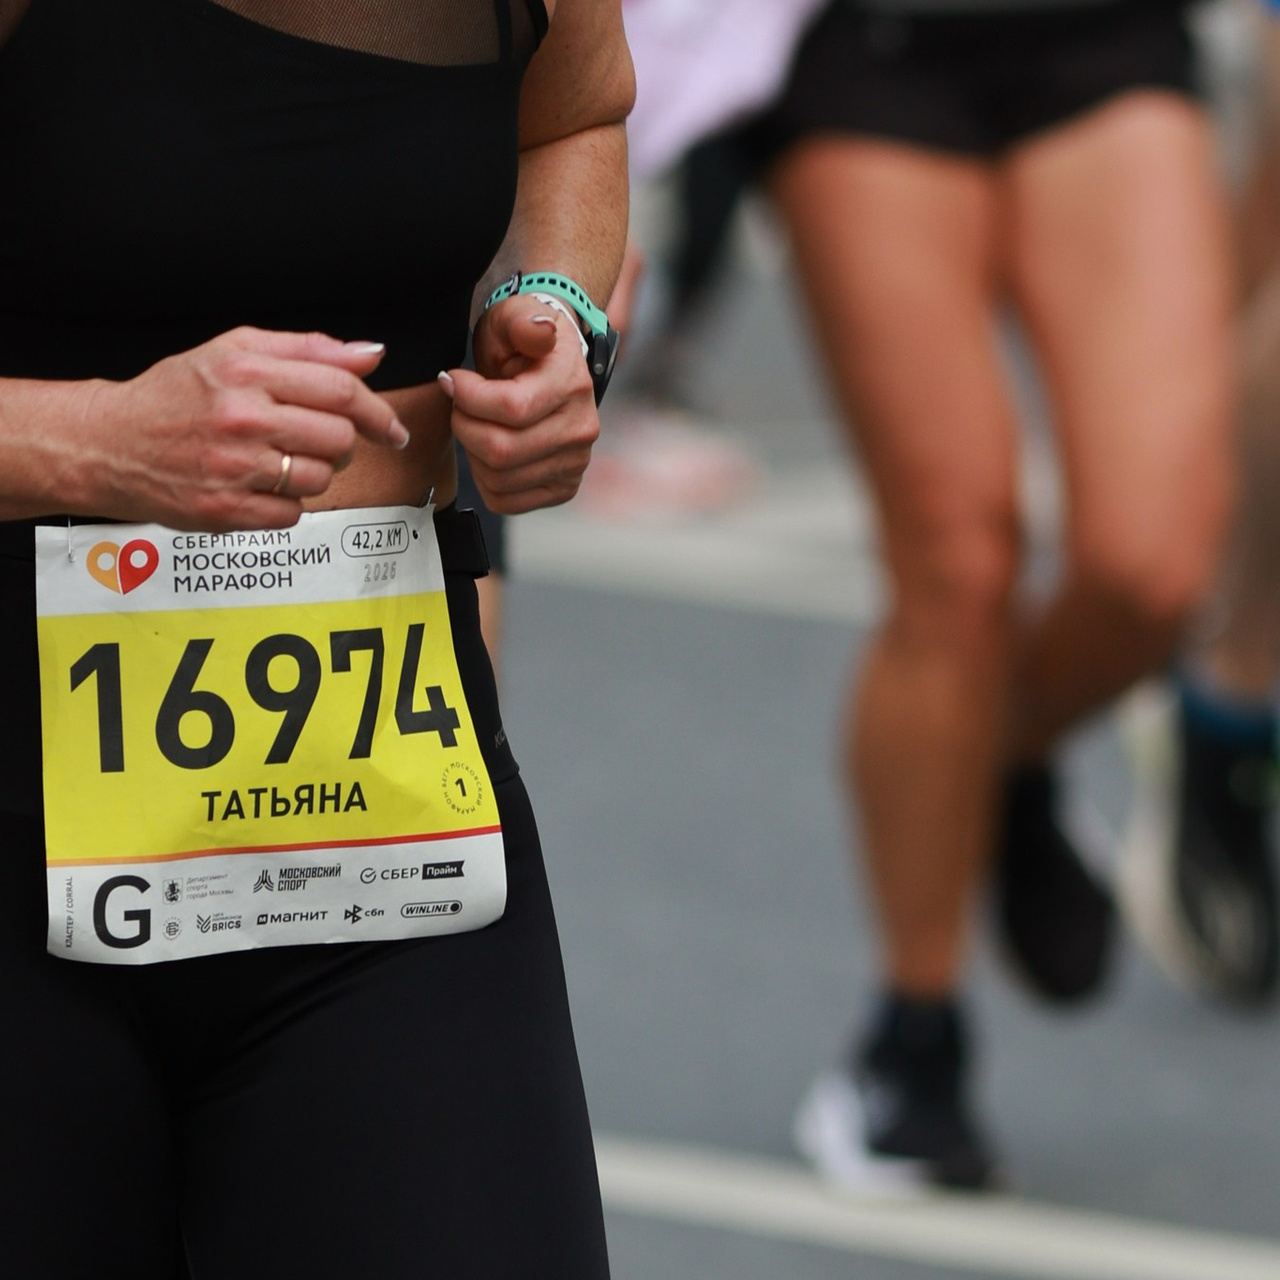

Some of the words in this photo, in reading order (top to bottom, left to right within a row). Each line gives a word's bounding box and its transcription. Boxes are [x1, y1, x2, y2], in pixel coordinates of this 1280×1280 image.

[172, 528, 291, 549] СБЕРПРАЙМ
[352, 530, 383, 551] 42,2
[173, 543, 331, 571] МОСКОВСКИЙ
[173, 571, 293, 593] МАРАФОН
[70, 623, 461, 773] 16974
[455, 778, 467, 797] 1
[201, 781, 368, 822] ТАТЬЯНА
[279, 863, 341, 879] МОСКОВСКИЙ
[380, 867, 419, 880] СБЕР
[426, 865, 458, 876] Прайм
[66, 876, 74, 909] CORRAL
[278, 879, 307, 891] СПОРТ
[93, 875, 151, 949] G
[406, 904, 448, 915] WINLINE
[212, 920, 242, 932] BRICS
